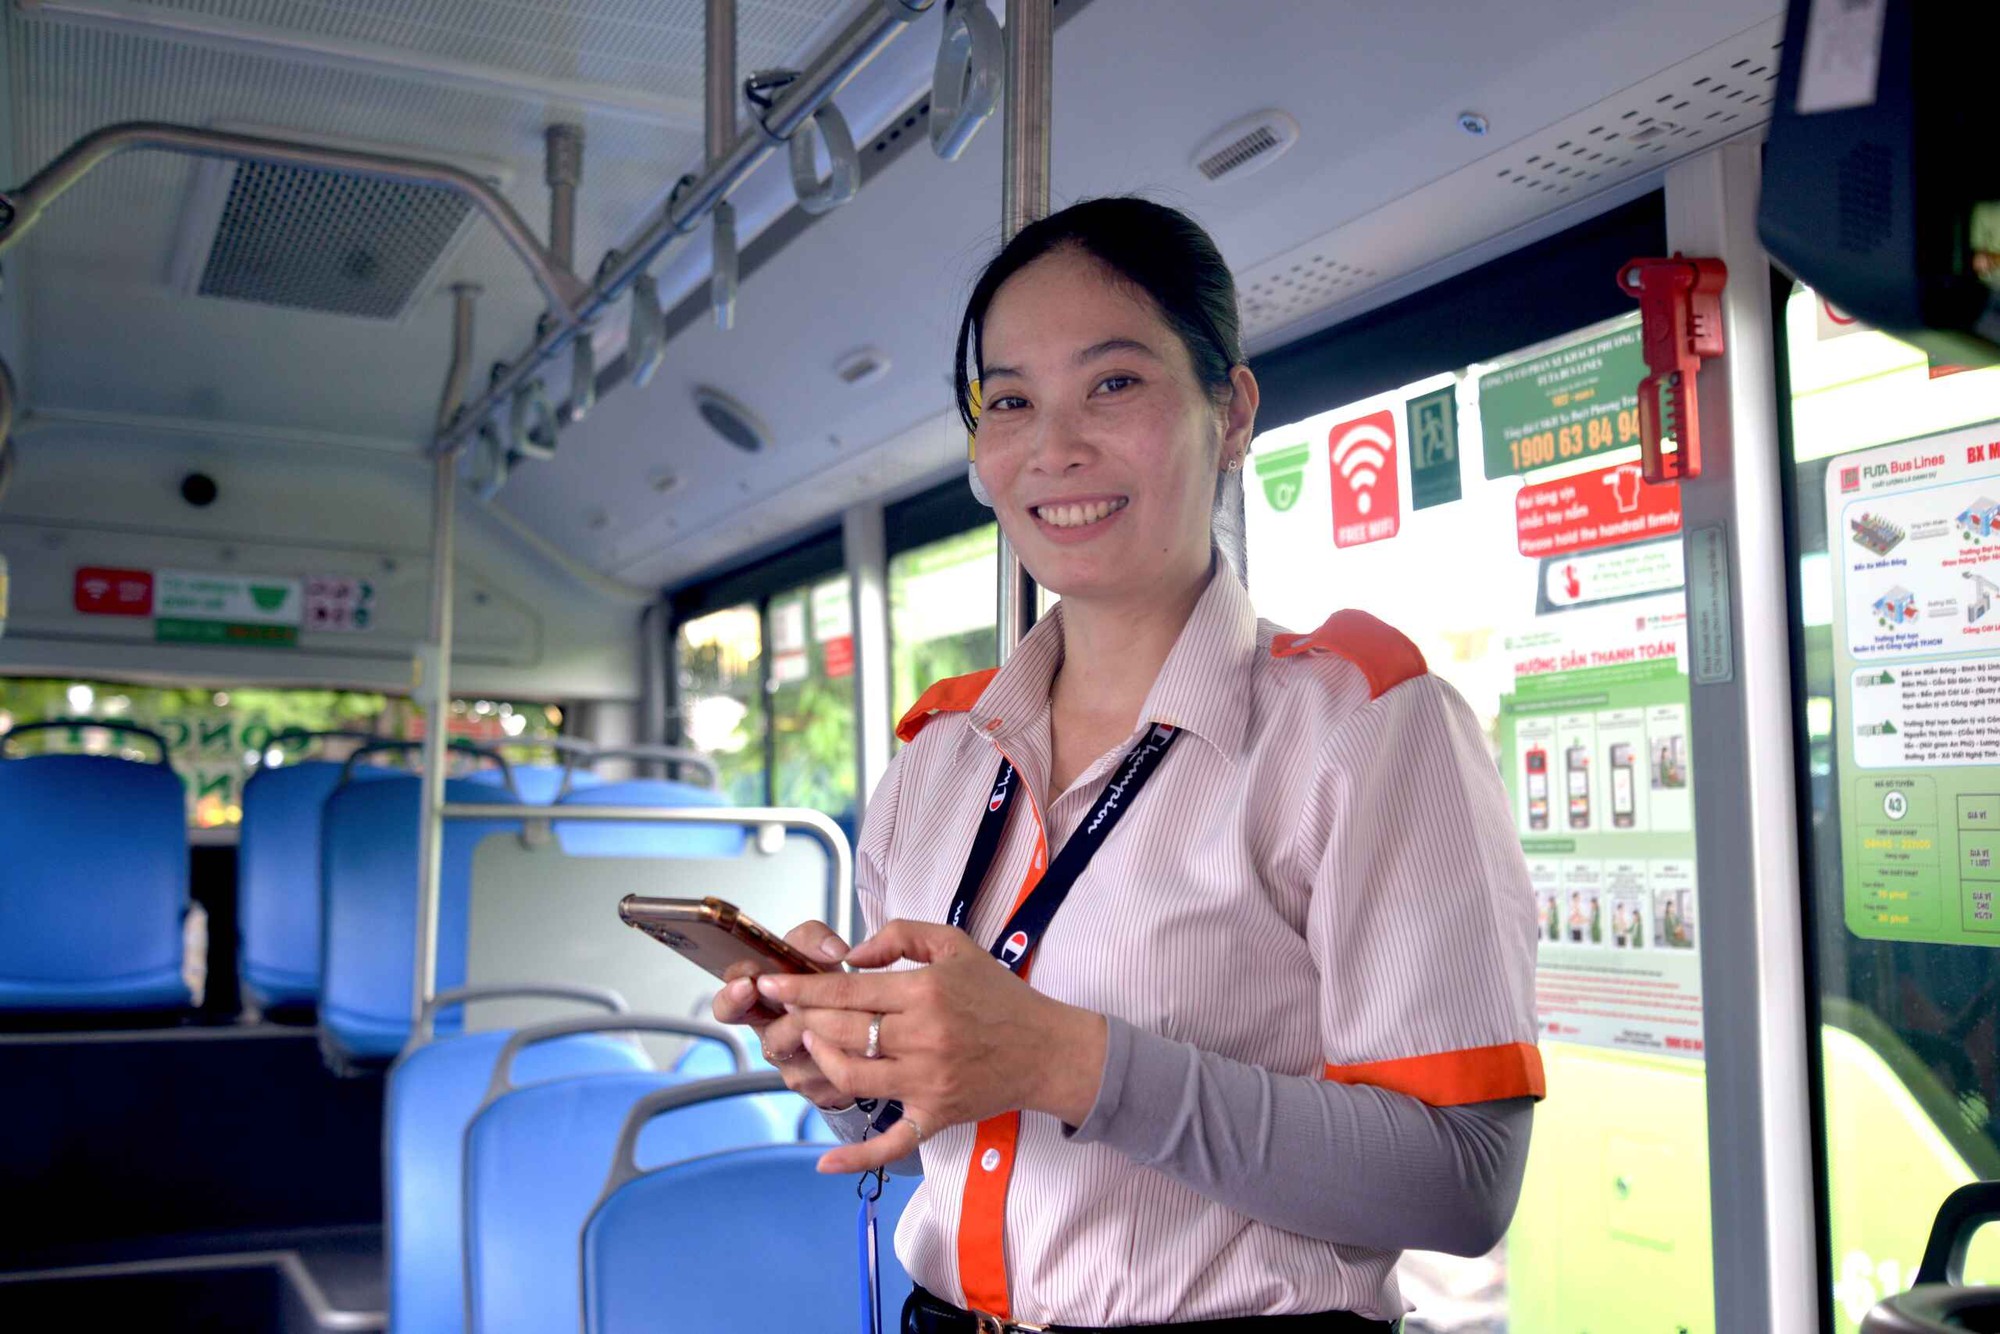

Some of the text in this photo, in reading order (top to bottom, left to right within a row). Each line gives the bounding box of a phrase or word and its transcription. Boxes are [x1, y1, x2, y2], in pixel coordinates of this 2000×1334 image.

[1509, 431, 1555, 470] 1900
[1559, 424, 1583, 457] 63
[1588, 416, 1613, 450] 84
[1967, 445, 1985, 464] BX
[1863, 454, 1945, 478] FUTA Bus Lines
[1338, 516, 1395, 543] FREE WIFI
[1520, 509, 1680, 552] Please hold the handrail firmly
[1546, 510, 1563, 526] tay
[1590, 647, 1635, 666] THANH
[1638, 640, 1676, 659] TOÁN
[1888, 798, 1902, 812] 43
